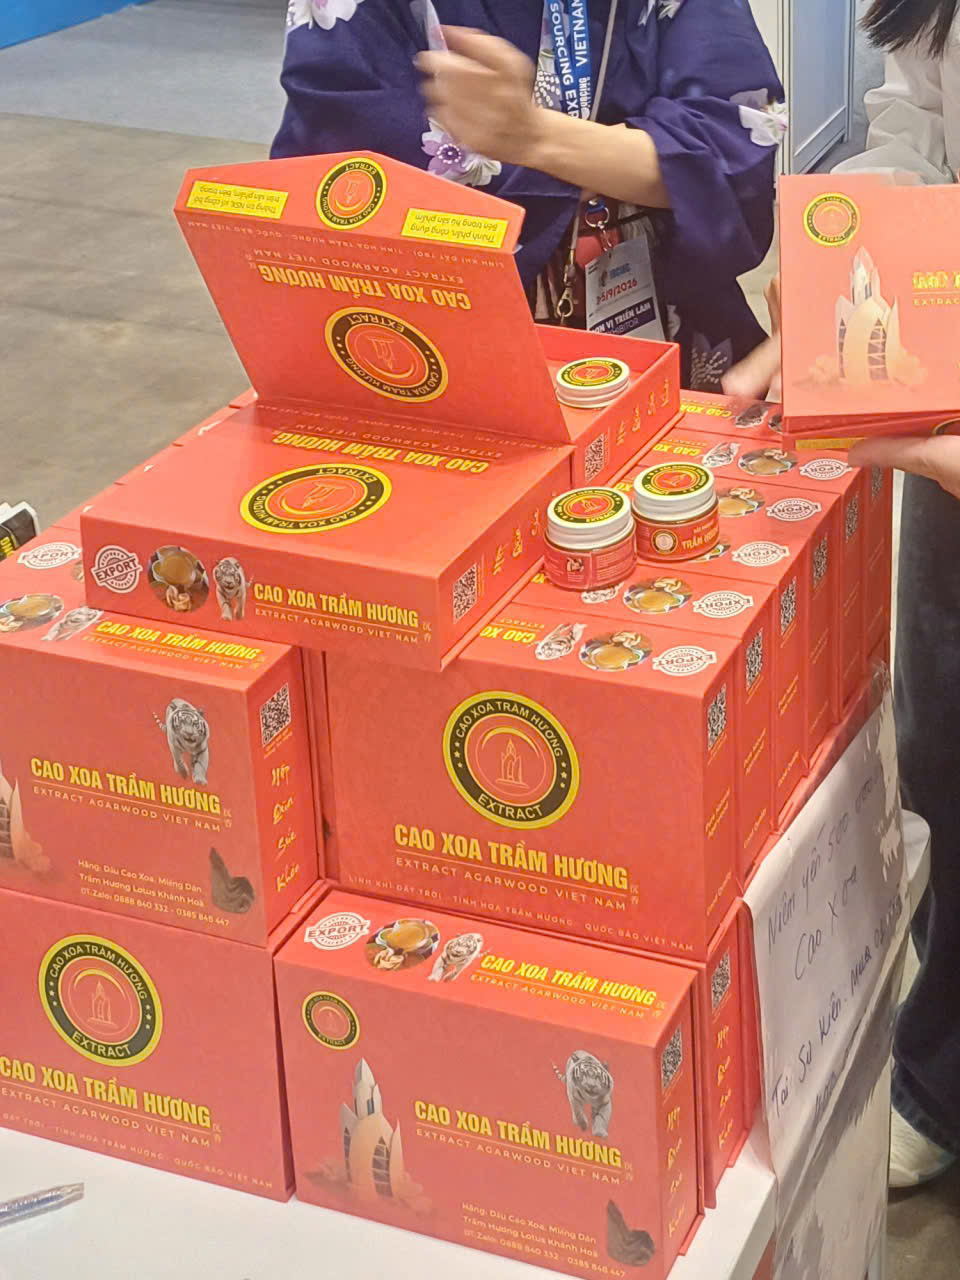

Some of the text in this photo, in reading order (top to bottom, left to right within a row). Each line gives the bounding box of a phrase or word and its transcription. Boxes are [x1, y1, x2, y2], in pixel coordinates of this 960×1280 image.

[551, 3, 574, 85] SOURCING
[94, 558, 419, 628] EXPORT CAO XOA TRẦM HƯƠNG
[30, 757, 222, 815] CAO XOA TRẦM HƯƠNG
[477, 793, 543, 820] EXTRACT
[394, 824, 629, 890] CAO XOA TRẦM HƯƠNG
[396, 857, 626, 911] EXTRACT AGARWOOD VIET NAM
[72, 1030, 132, 1058] EXTRACT
[0, 1056, 212, 1128] CAO XOA TRẦM HƯƠNG
[414, 1101, 622, 1168] CAO XOA TRẦM HƯƠNG
